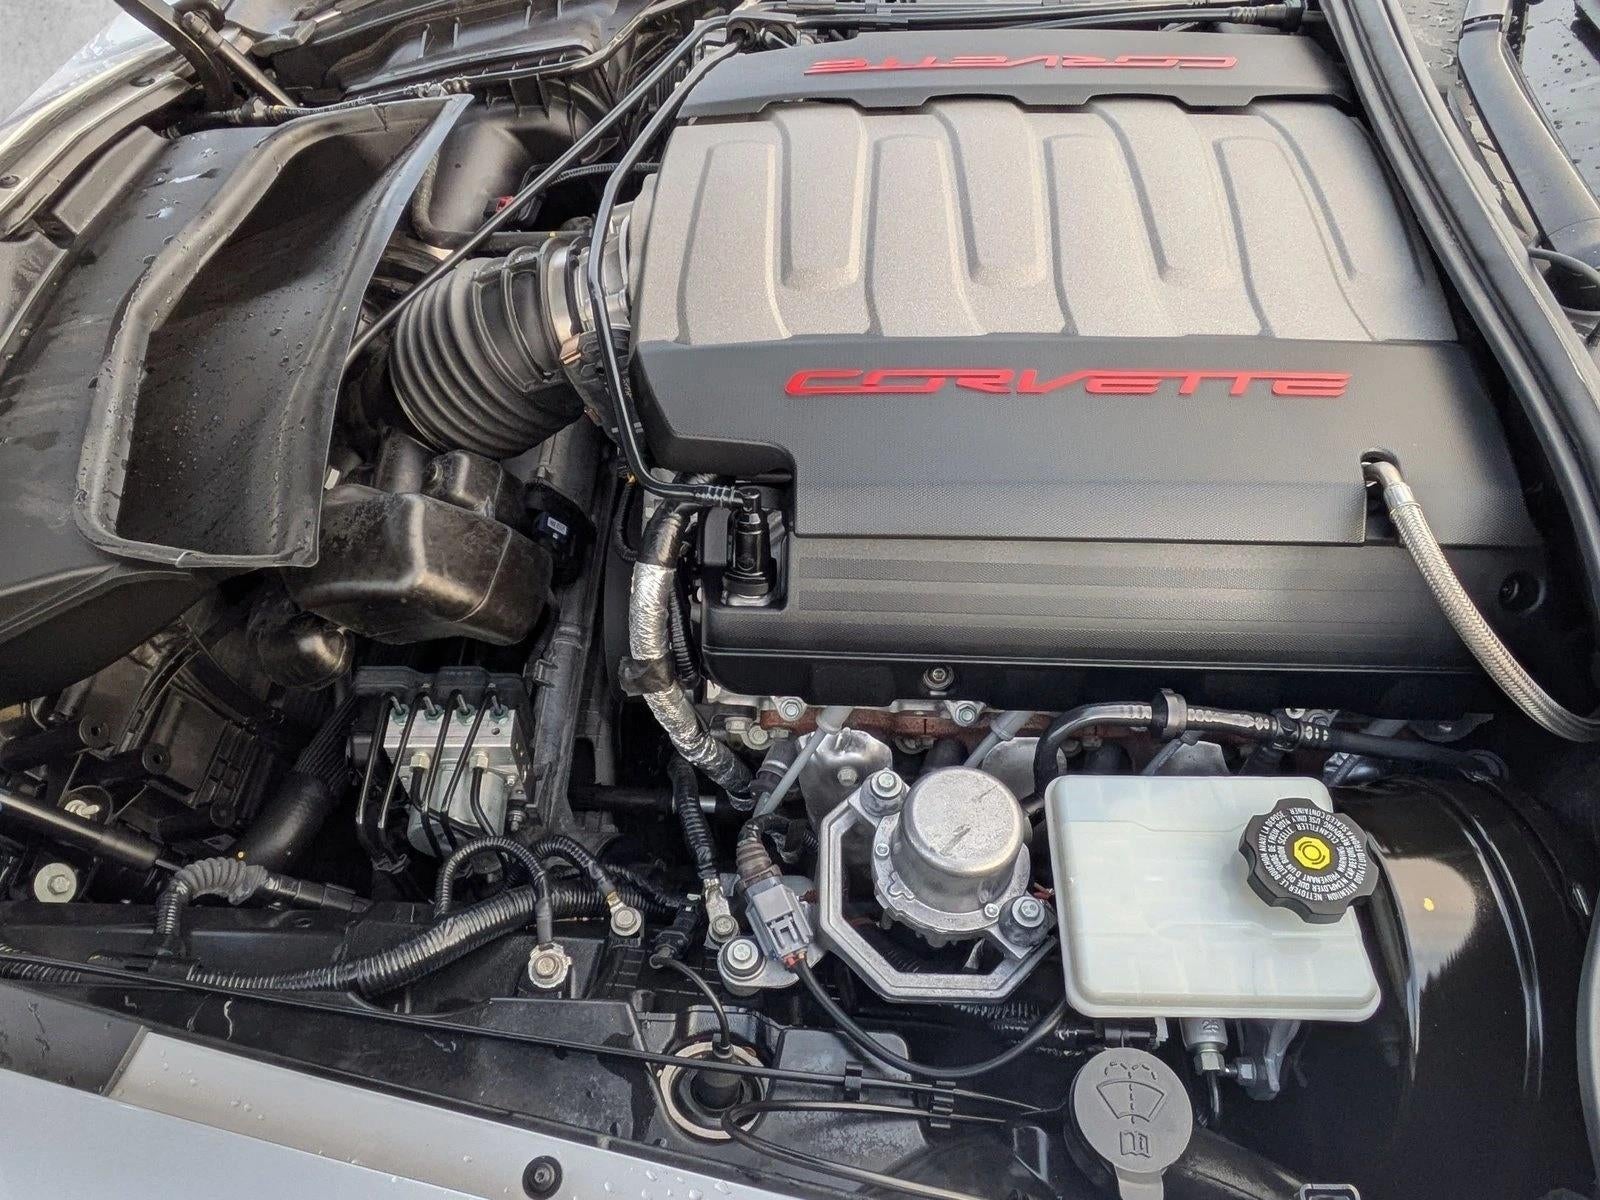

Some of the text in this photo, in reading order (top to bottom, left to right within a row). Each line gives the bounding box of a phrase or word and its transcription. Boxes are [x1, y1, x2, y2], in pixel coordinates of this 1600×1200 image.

[804, 55, 1238, 75] CORVETTE
[784, 368, 1351, 398] CORVETTE
[1290, 814, 1308, 824] ONLY
[1308, 815, 1321, 825] USE
[1325, 813, 1350, 833] SEALED
[1260, 824, 1271, 835] LA
[1294, 822, 1320, 832] FILLER
[1344, 829, 1354, 837] A
[1319, 826, 1340, 845] CLEAN
[1348, 834, 1364, 852] FROM
[1260, 853, 1282, 881] BOUCHON
[1278, 878, 1290, 888] LE
[1295, 879, 1310, 891] QUE
[1302, 870, 1341, 885] PROVENANT
[1287, 883, 1324, 902] NETTOYER
